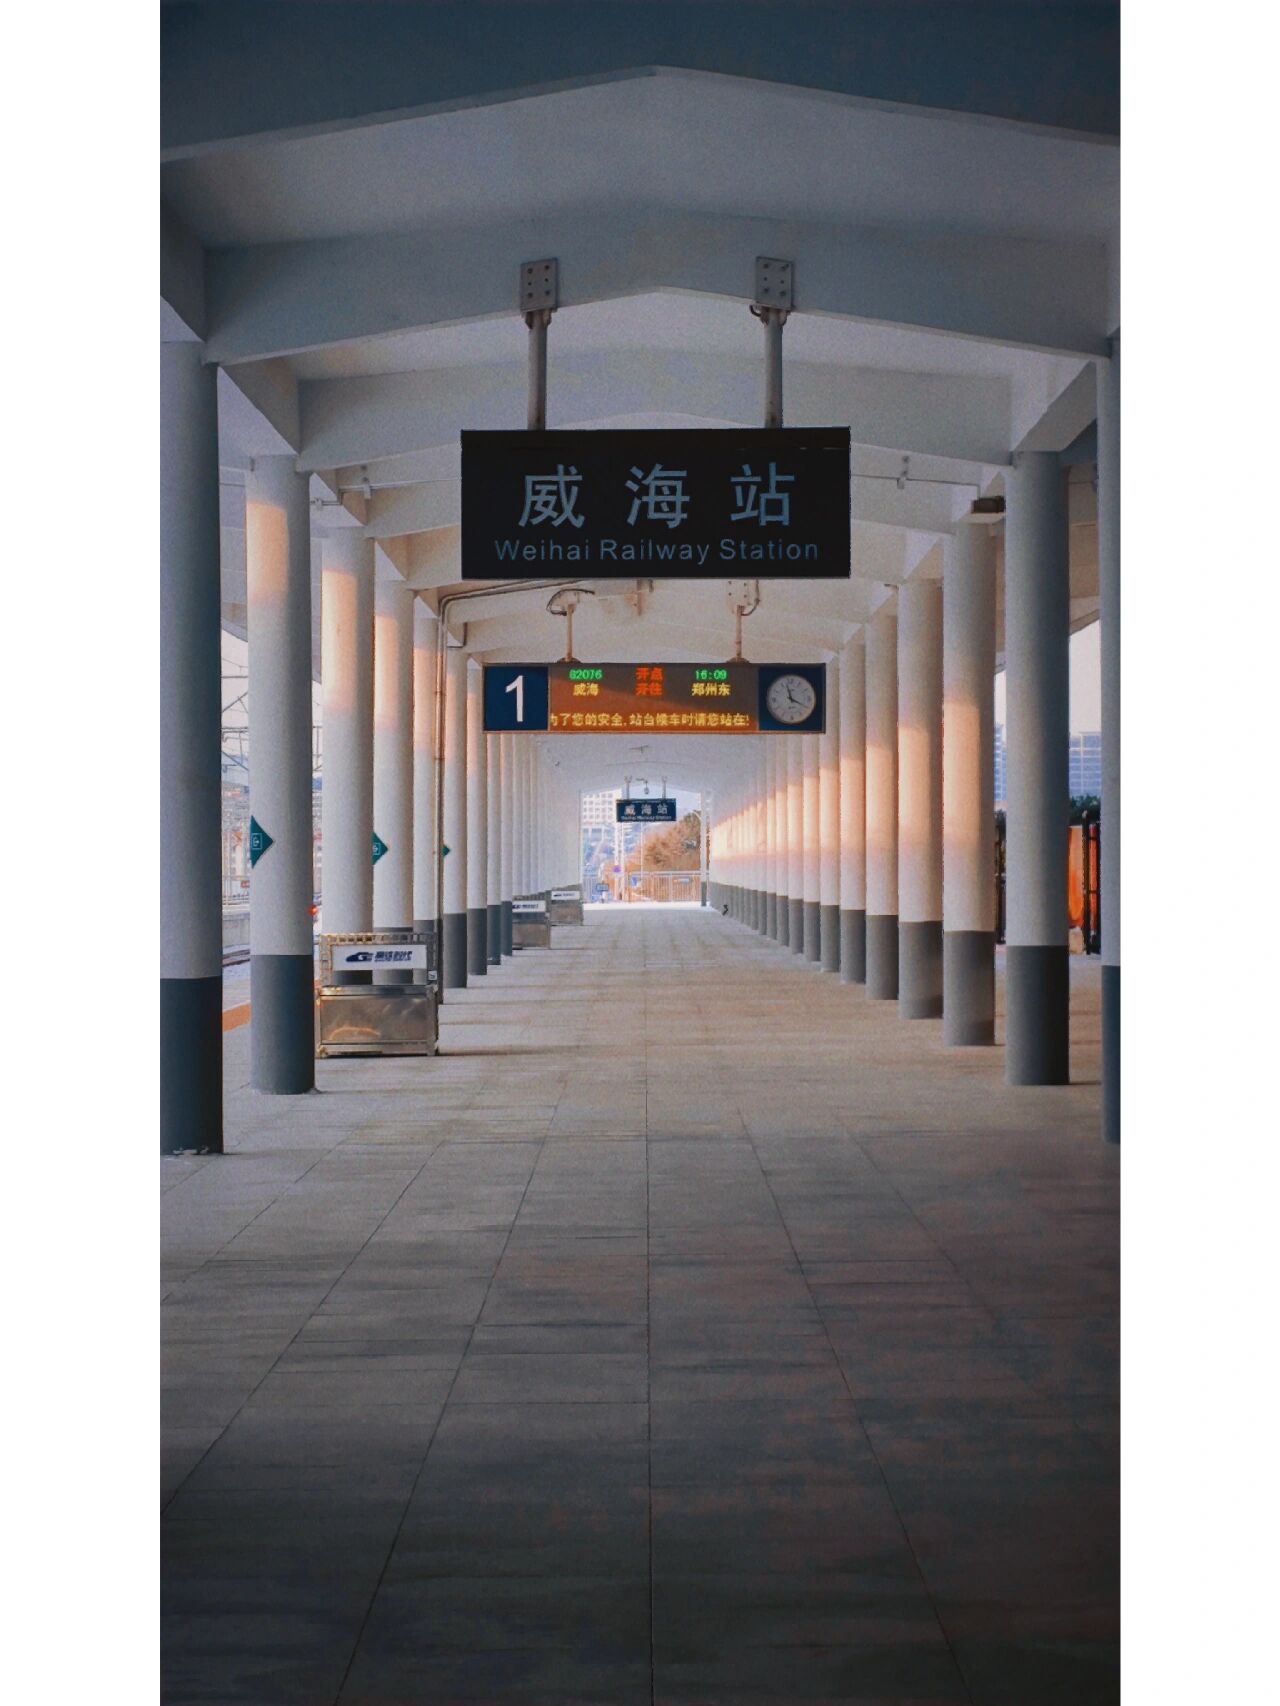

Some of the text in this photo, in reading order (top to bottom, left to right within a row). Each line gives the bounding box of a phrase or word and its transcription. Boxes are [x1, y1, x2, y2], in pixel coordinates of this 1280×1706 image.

[518, 462, 795, 529] 威海站
[494, 537, 818, 565] Weihai Railway Station
[695, 669, 728, 680] 16:09
[505, 675, 524, 723] 1
[573, 682, 731, 696] 威海 开往 郑州东
